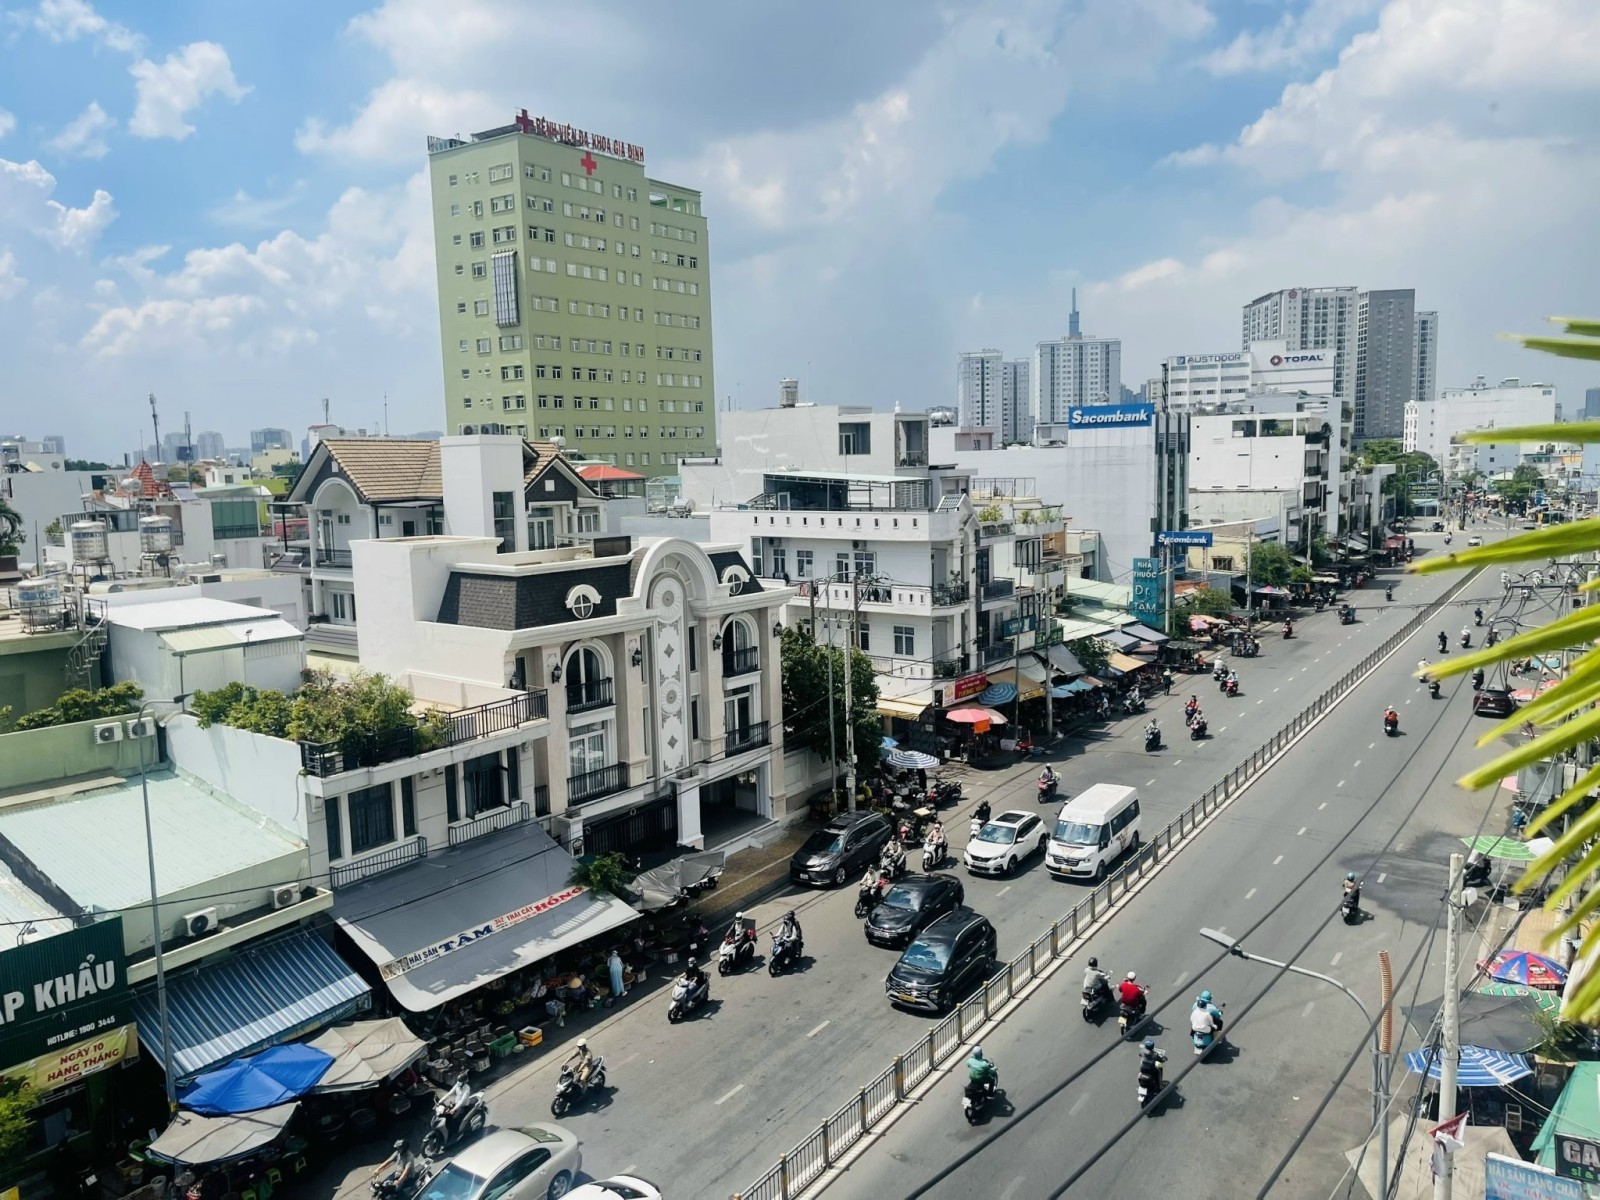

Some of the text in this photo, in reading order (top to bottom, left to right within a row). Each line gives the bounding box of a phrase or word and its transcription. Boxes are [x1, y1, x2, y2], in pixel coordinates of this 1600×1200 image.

[591, 133, 611, 153] KHOA
[613, 139, 626, 157] GIA
[1187, 353, 1241, 363] AUSTDOOR
[1284, 355, 1323, 364] TOPAL
[1071, 409, 1149, 424] Sacombank
[1133, 569, 1157, 578] THUỐC
[1135, 584, 1151, 595] Dr.
[408, 952, 422, 965] HẢI
[422, 946, 439, 959] SẢN
[438, 924, 493, 952] TÂM
[33, 953, 116, 1012] KHẨU
[47, 1029, 78, 1046] HOTLINE:
[79, 1022, 95, 1035] 1900
[47, 1063, 80, 1082] HÀNG
[82, 1048, 120, 1068] THÁNG
[60, 1042, 104, 1065] NGÀY 10
